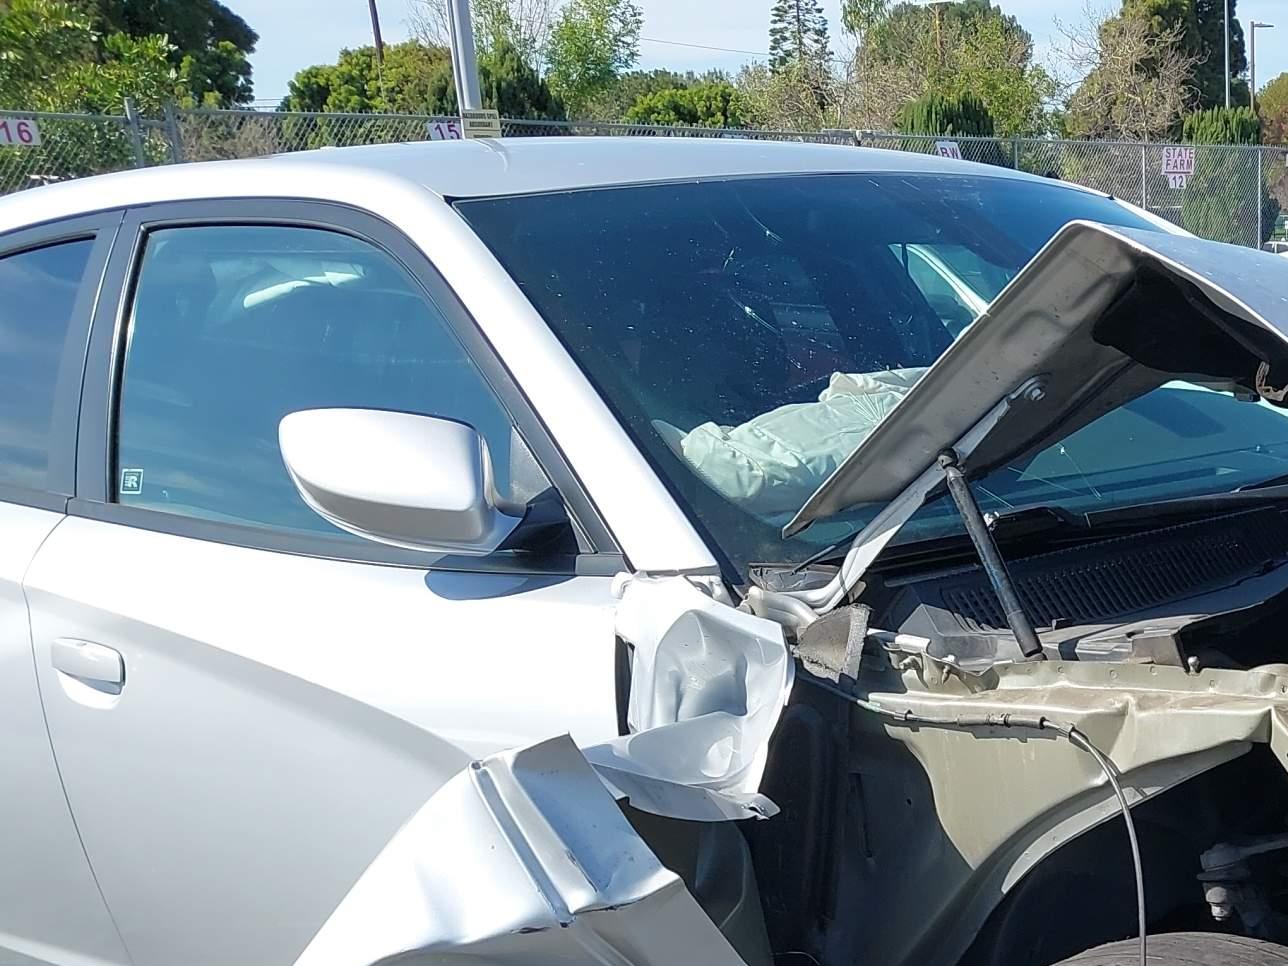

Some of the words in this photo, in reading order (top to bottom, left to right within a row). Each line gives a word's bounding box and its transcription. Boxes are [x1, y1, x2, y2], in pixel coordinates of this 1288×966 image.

[0, 121, 33, 143] 16
[434, 121, 460, 139] 15
[1165, 147, 1194, 159] STATE
[1165, 159, 1193, 170] FARM
[1172, 175, 1185, 188] 12
